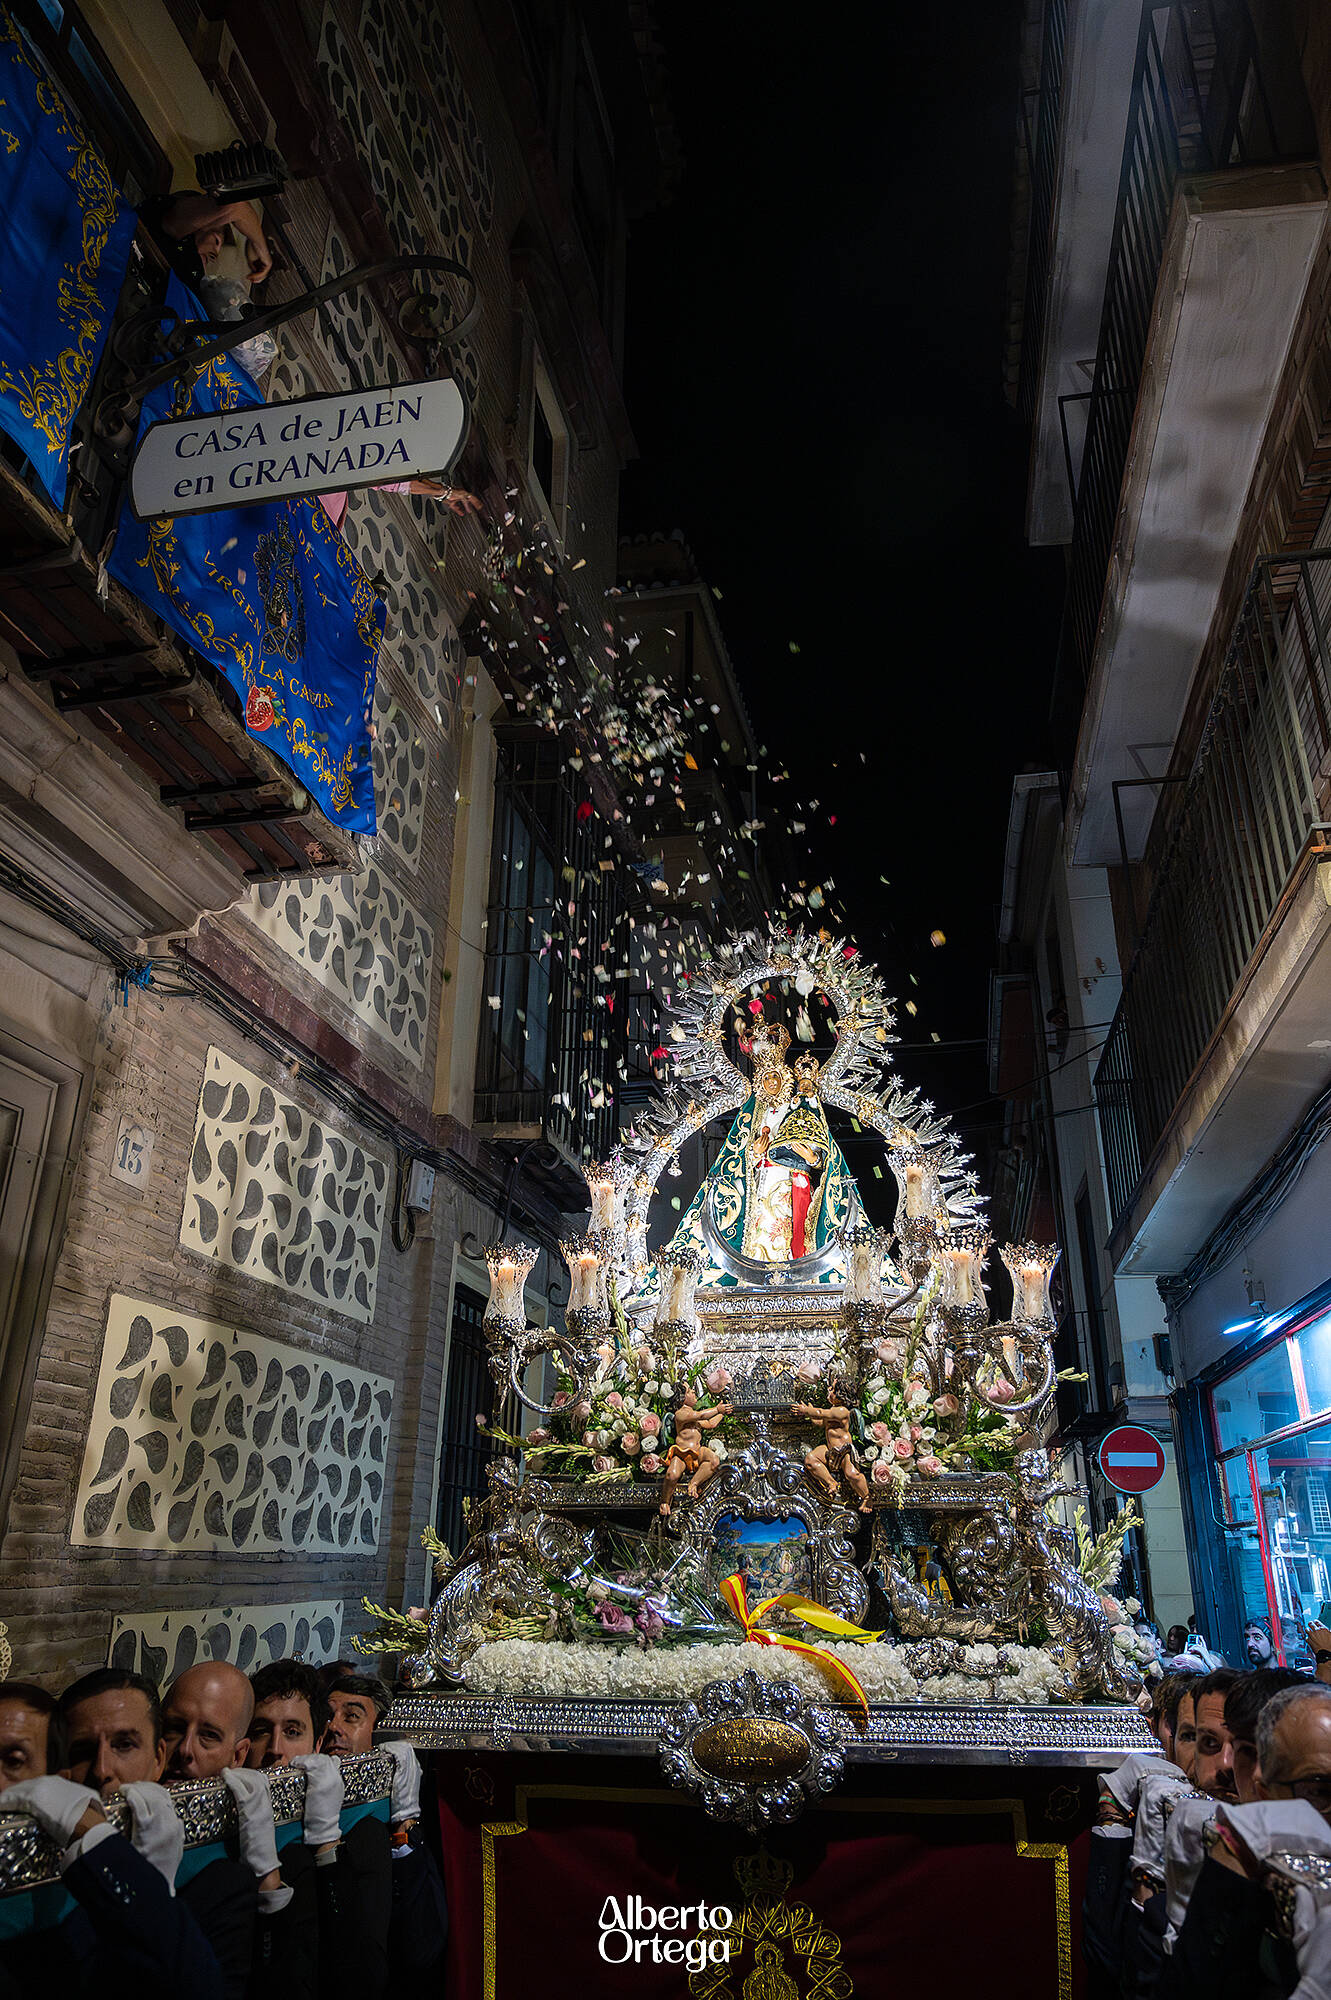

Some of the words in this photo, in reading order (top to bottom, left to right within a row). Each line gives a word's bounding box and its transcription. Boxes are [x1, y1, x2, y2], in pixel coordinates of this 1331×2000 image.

[175, 422, 267, 458] CASA
[280, 415, 322, 442] de
[329, 396, 423, 441] JAEN
[174, 475, 214, 497] en
[228, 438, 411, 489] GRANADA
[204, 549, 262, 636] VIRGEN
[258, 659, 285, 687] LA
